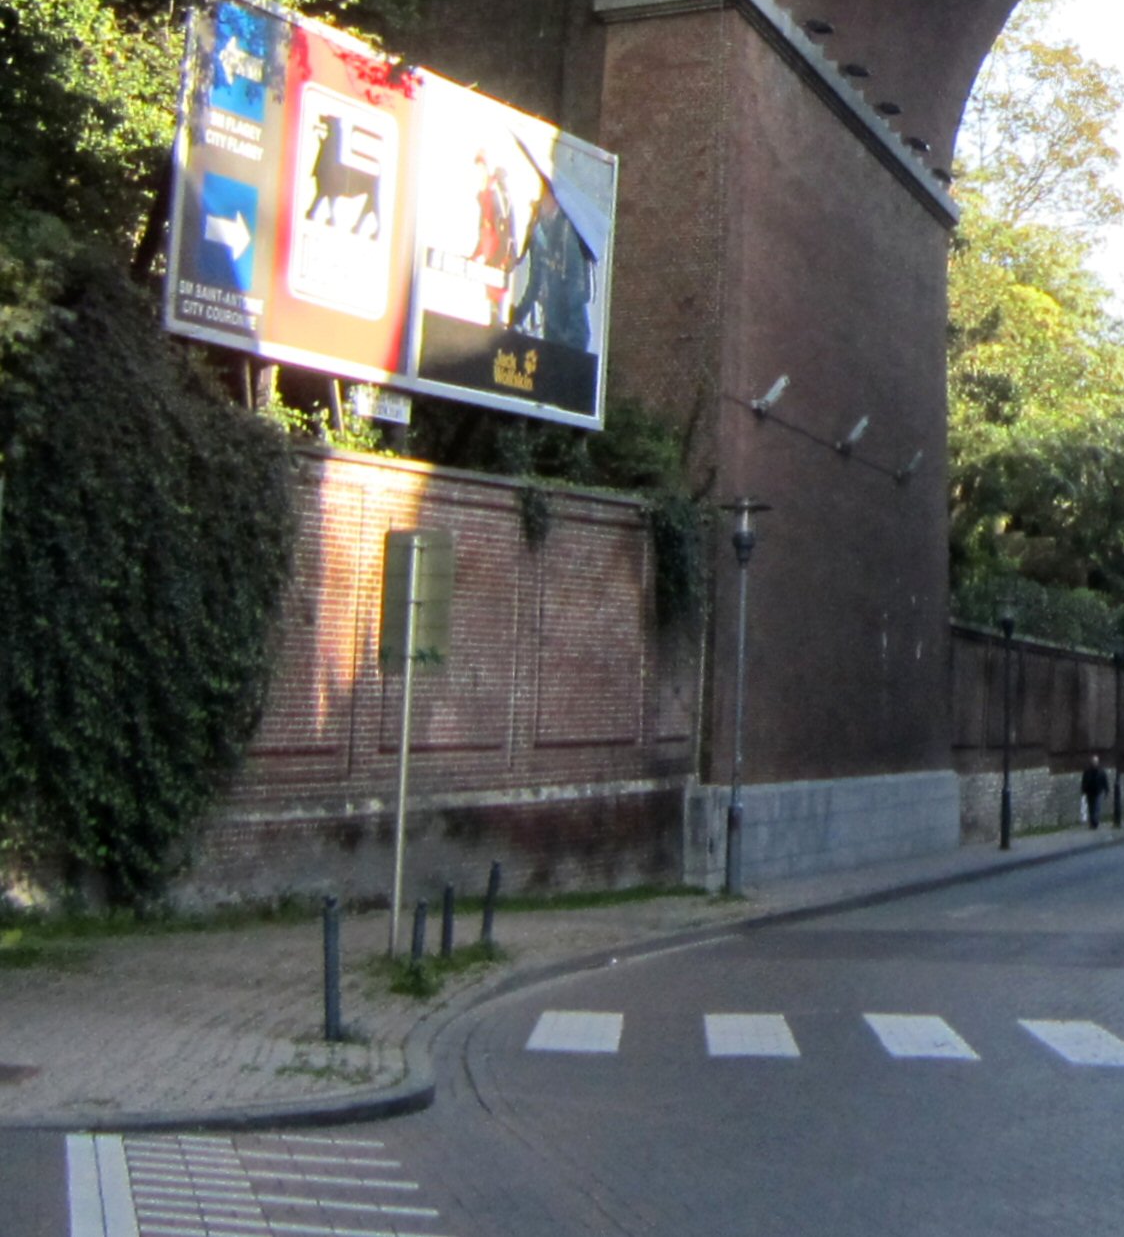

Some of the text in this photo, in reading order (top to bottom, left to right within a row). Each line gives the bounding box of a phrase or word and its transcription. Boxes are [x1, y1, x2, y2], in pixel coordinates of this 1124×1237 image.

[205, 128, 227, 149] CITY
[183, 299, 256, 331] CITY COURONE
[195, 283, 265, 316] SAINT-ANT
